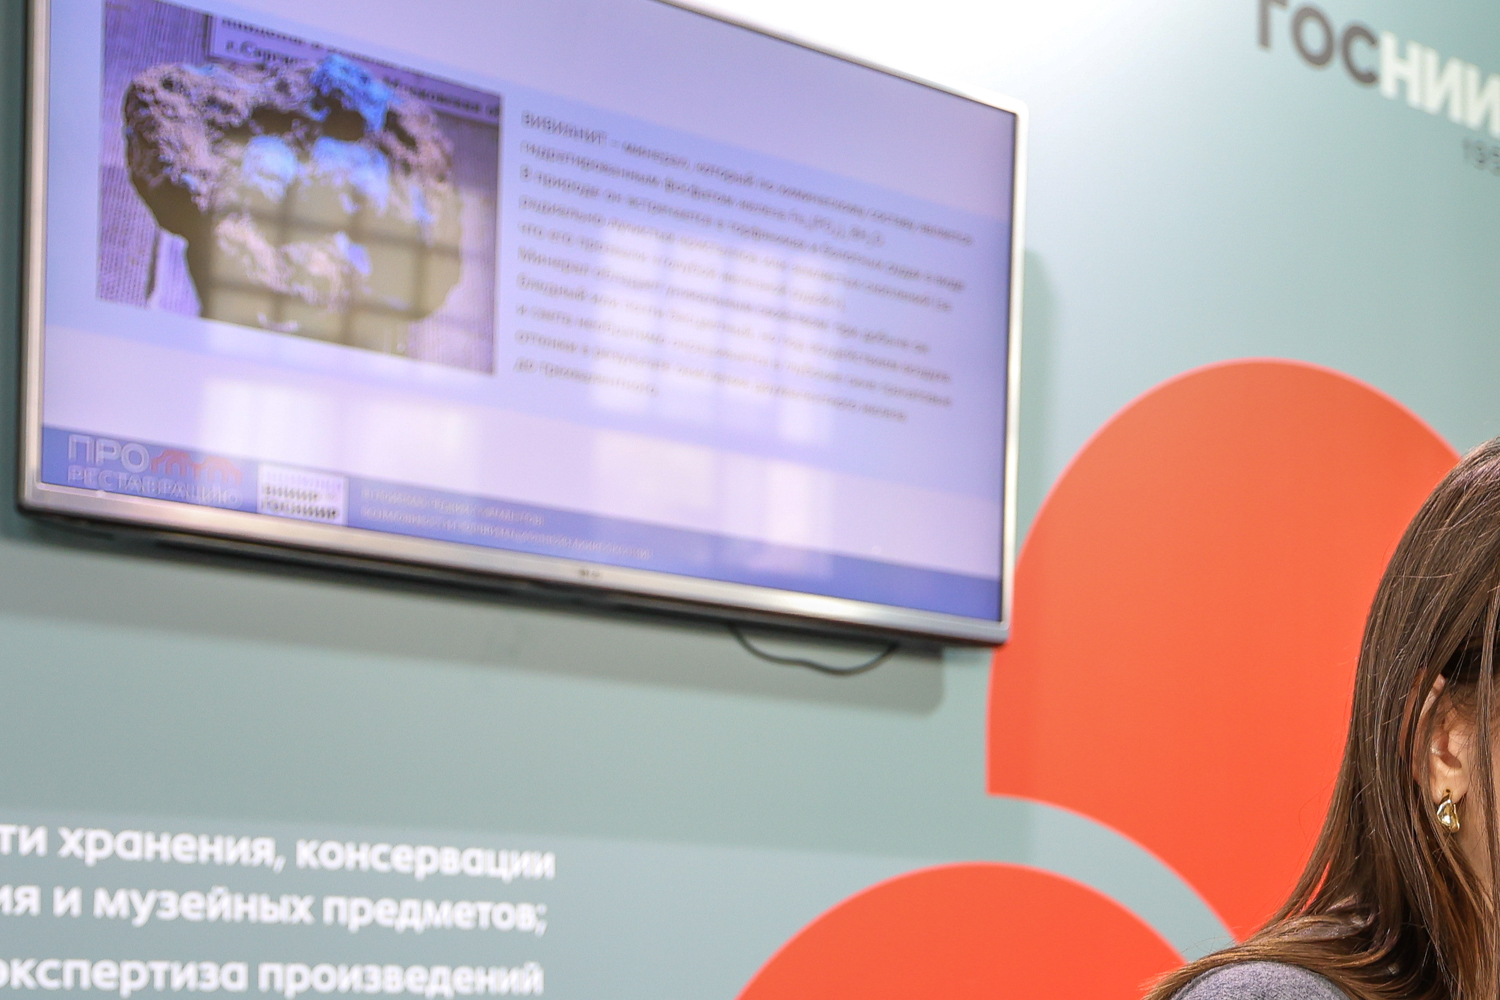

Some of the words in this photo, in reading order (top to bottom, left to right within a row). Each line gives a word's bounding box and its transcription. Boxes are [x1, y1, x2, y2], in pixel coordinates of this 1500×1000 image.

[68, 434, 150, 473] ПРО
[58, 827, 286, 874] хранения,
[296, 836, 556, 883] консервации
[53, 885, 82, 917] и
[93, 884, 315, 928] музейных
[323, 895, 548, 936] предметов;
[258, 960, 544, 999] произведений
